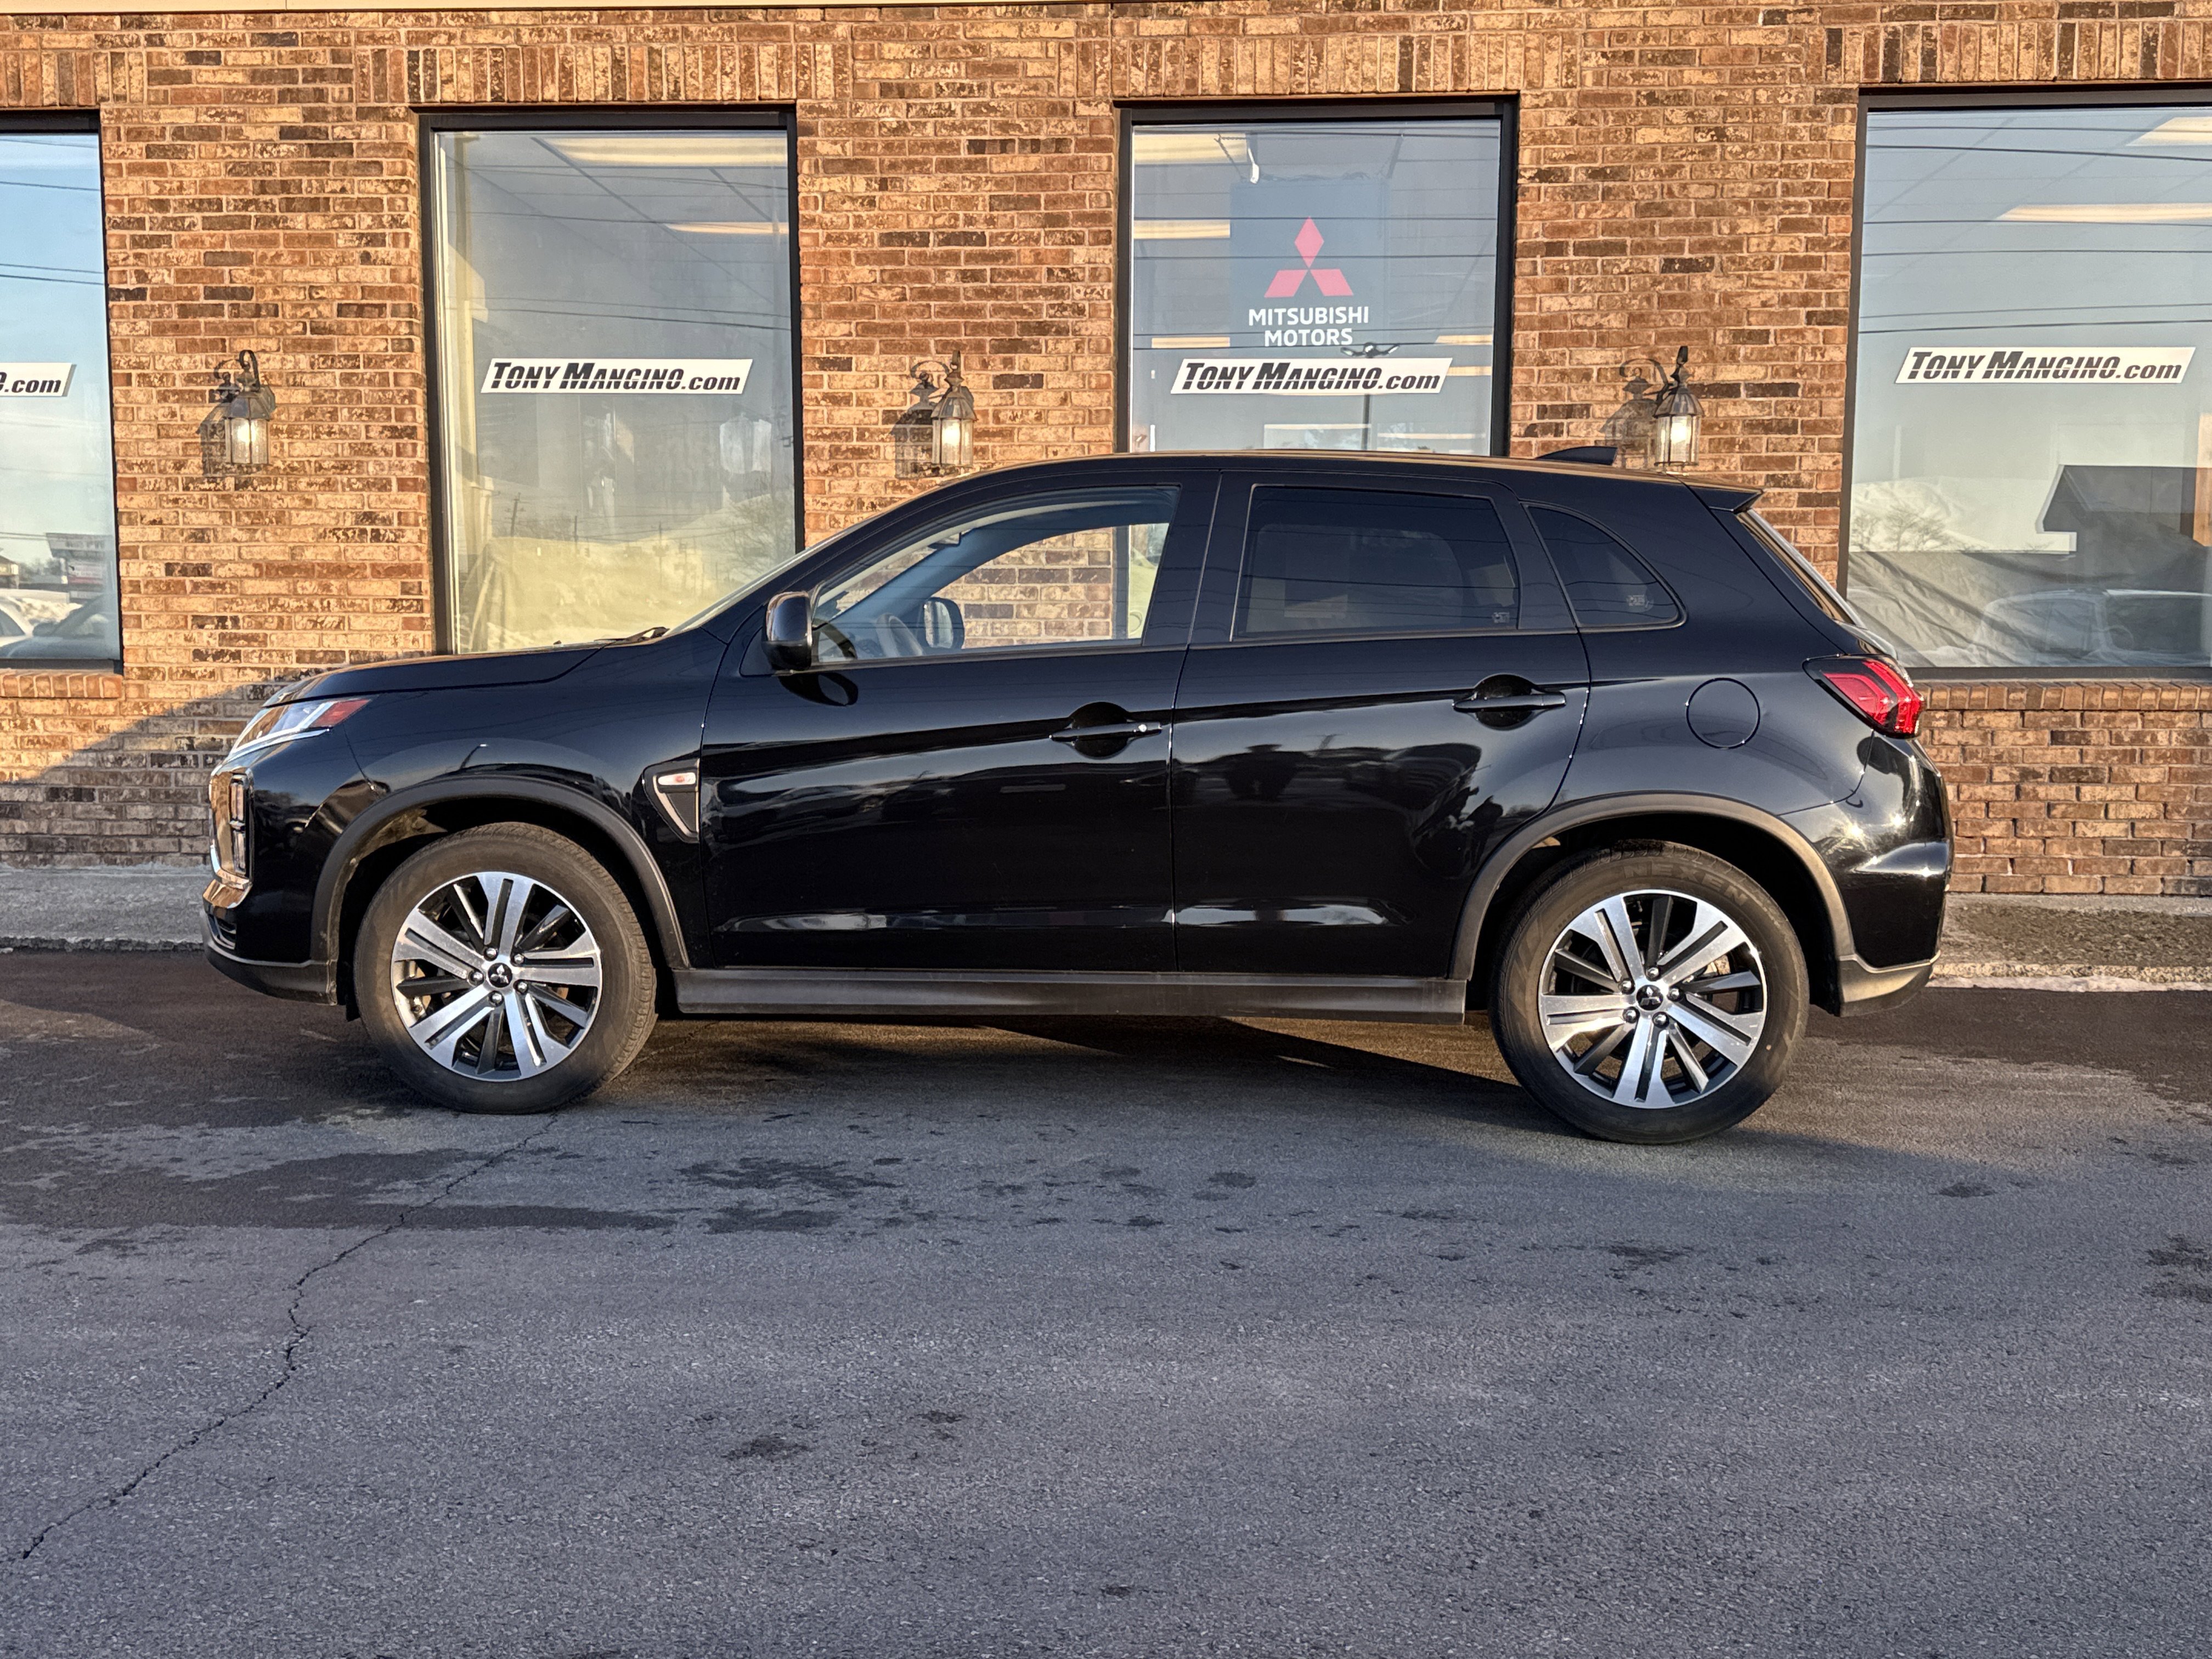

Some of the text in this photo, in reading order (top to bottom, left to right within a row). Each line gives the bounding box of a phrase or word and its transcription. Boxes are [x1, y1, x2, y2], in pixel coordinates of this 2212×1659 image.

[1249, 306, 1369, 326] MITSUBISHI
[1265, 328, 1353, 347] MOTORS
[491, 362, 741, 390] TONY MANGINO.com
[1182, 362, 1441, 390] TONY MANGINO.com
[1908, 351, 2182, 380] TONY MANGINO.com
[1623, 861, 1748, 906] NEXEN
